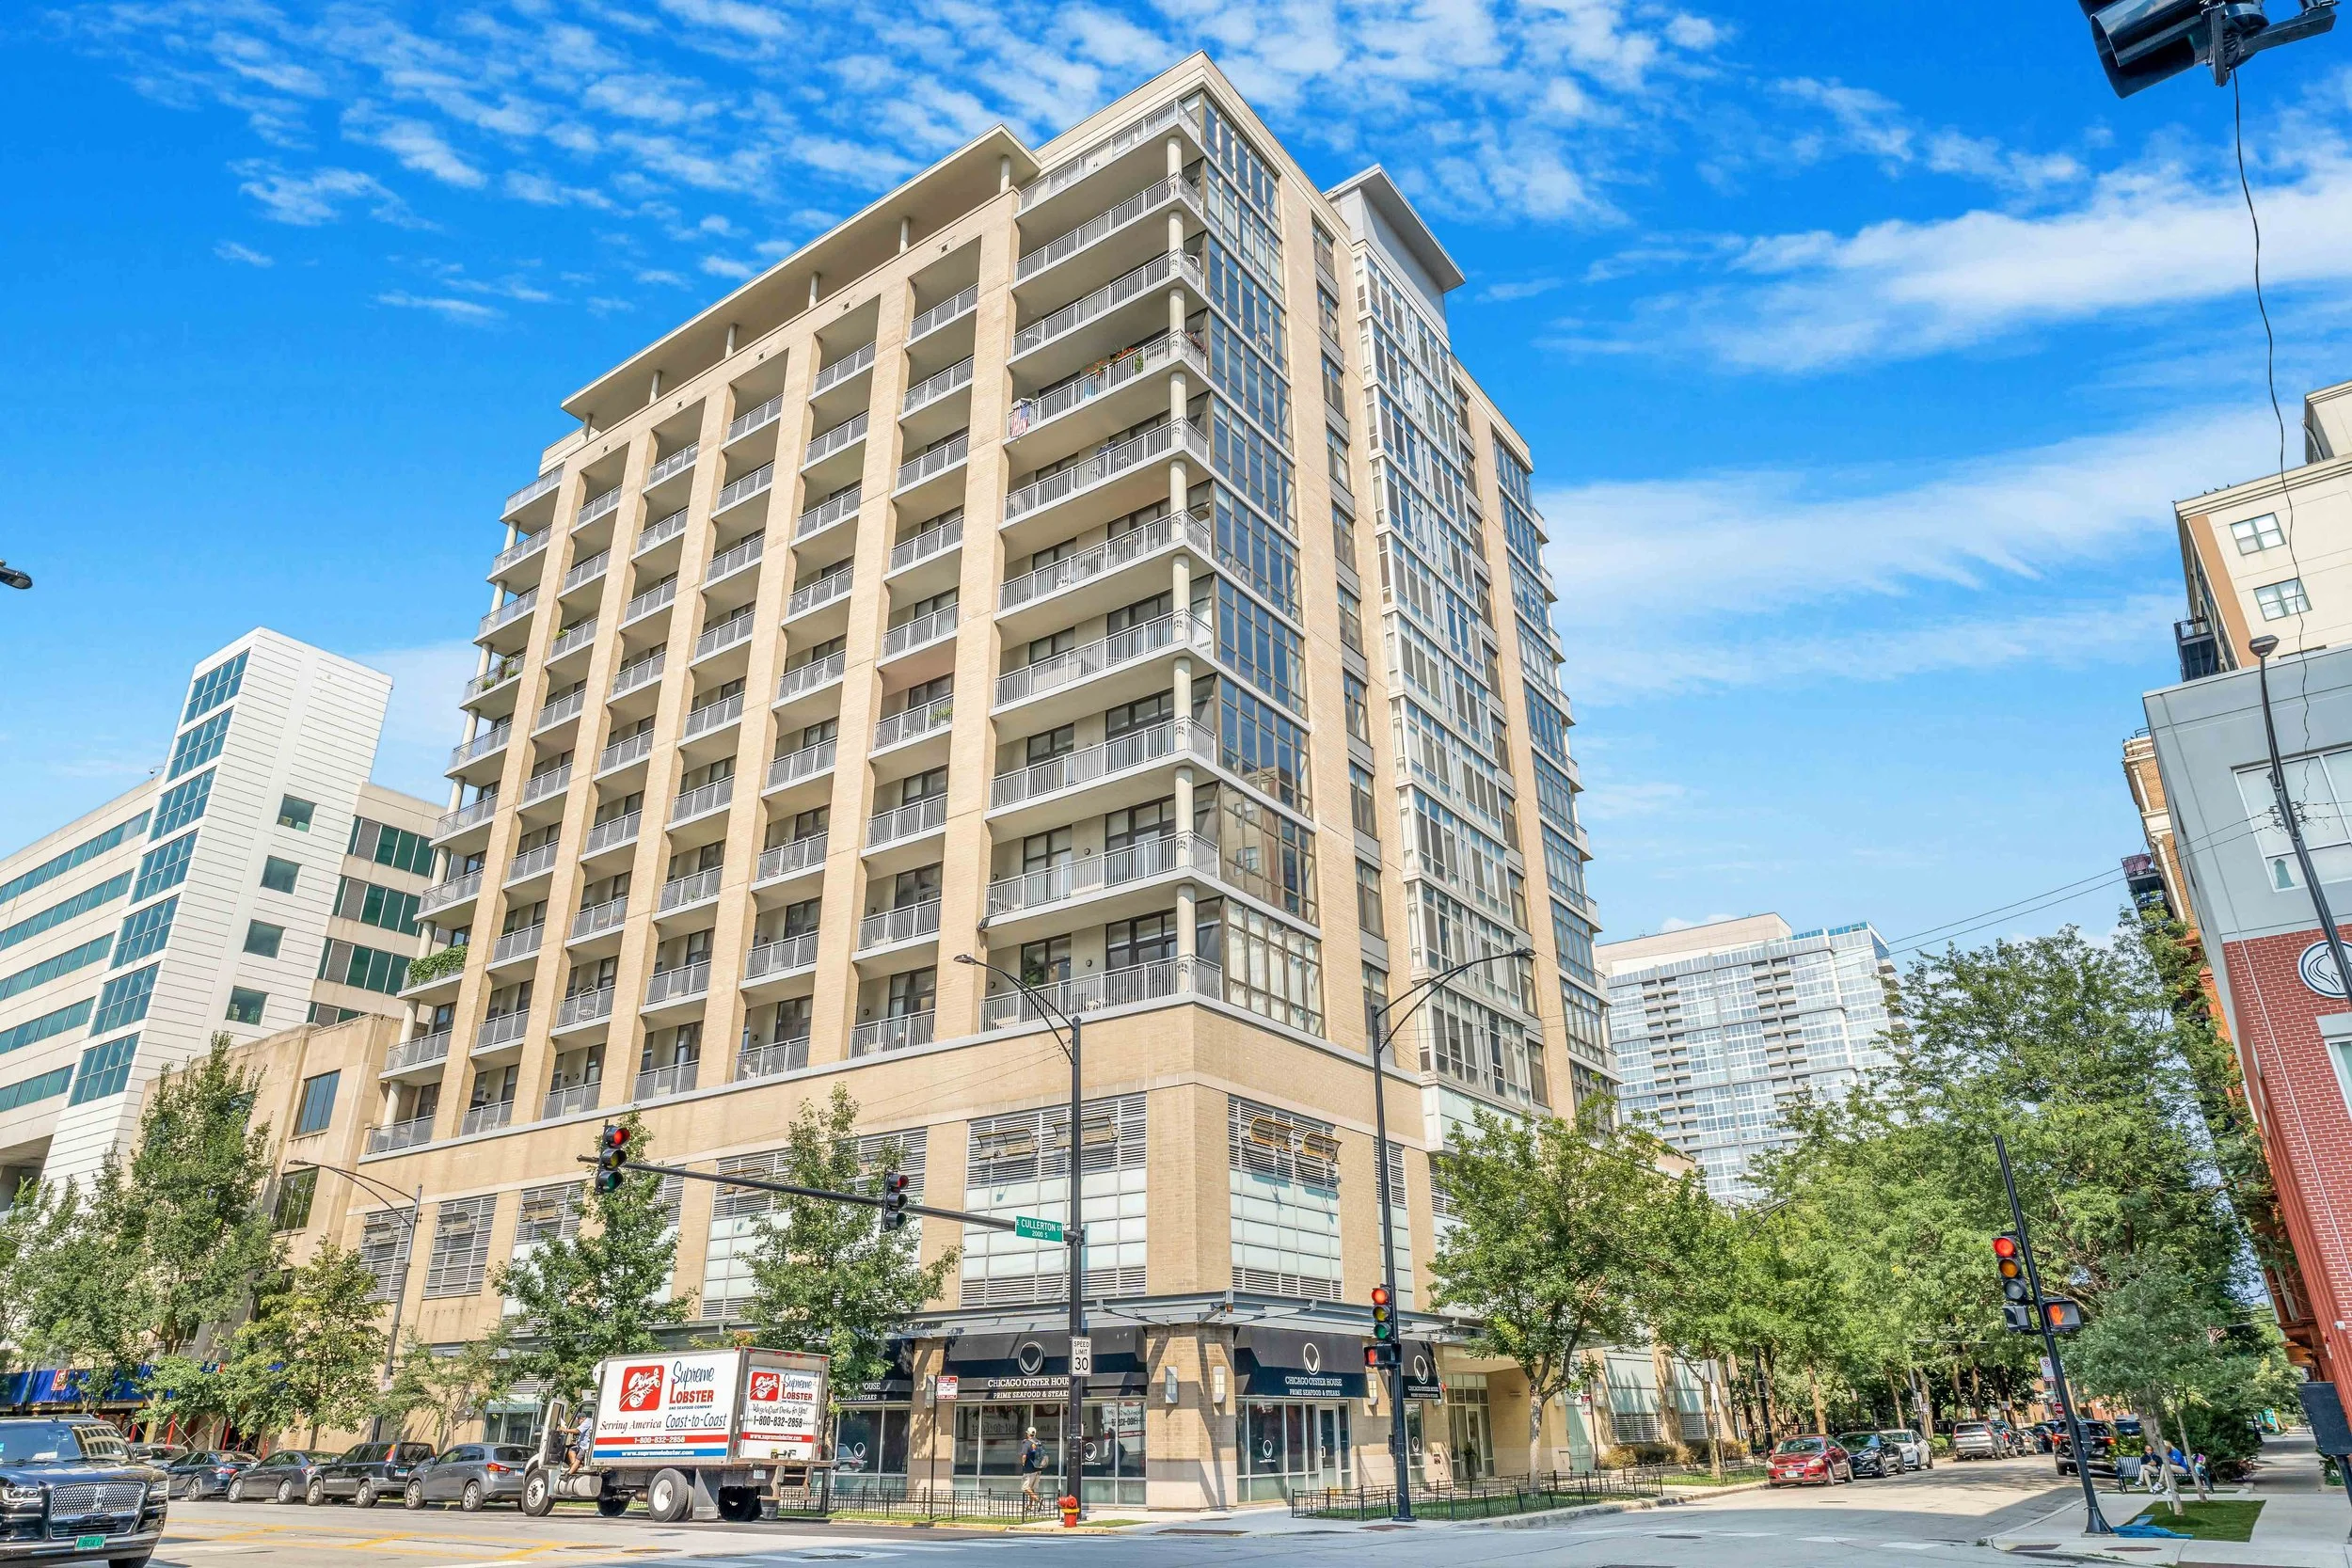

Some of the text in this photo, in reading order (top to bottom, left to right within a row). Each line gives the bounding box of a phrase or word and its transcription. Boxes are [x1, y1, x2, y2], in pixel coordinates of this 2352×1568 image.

[1021, 1219, 1056, 1231] CULLERTON
[1074, 1356, 1089, 1370] 30
[672, 1360, 715, 1390] Supreme
[783, 1373, 813, 1391] Supreme
[987, 1378, 1022, 1387] CHICAGO
[1022, 1377, 1050, 1386] OYSTER
[1284, 1376, 1343, 1386] CHICAGO OYSTER HOUSE
[669, 1378, 714, 1403] LOBSTER
[782, 1384, 813, 1402] LOBSTER
[600, 1412, 727, 1433] Serving America Coast-to-Coast
[754, 1415, 803, 1428] 1-800-832-2858
